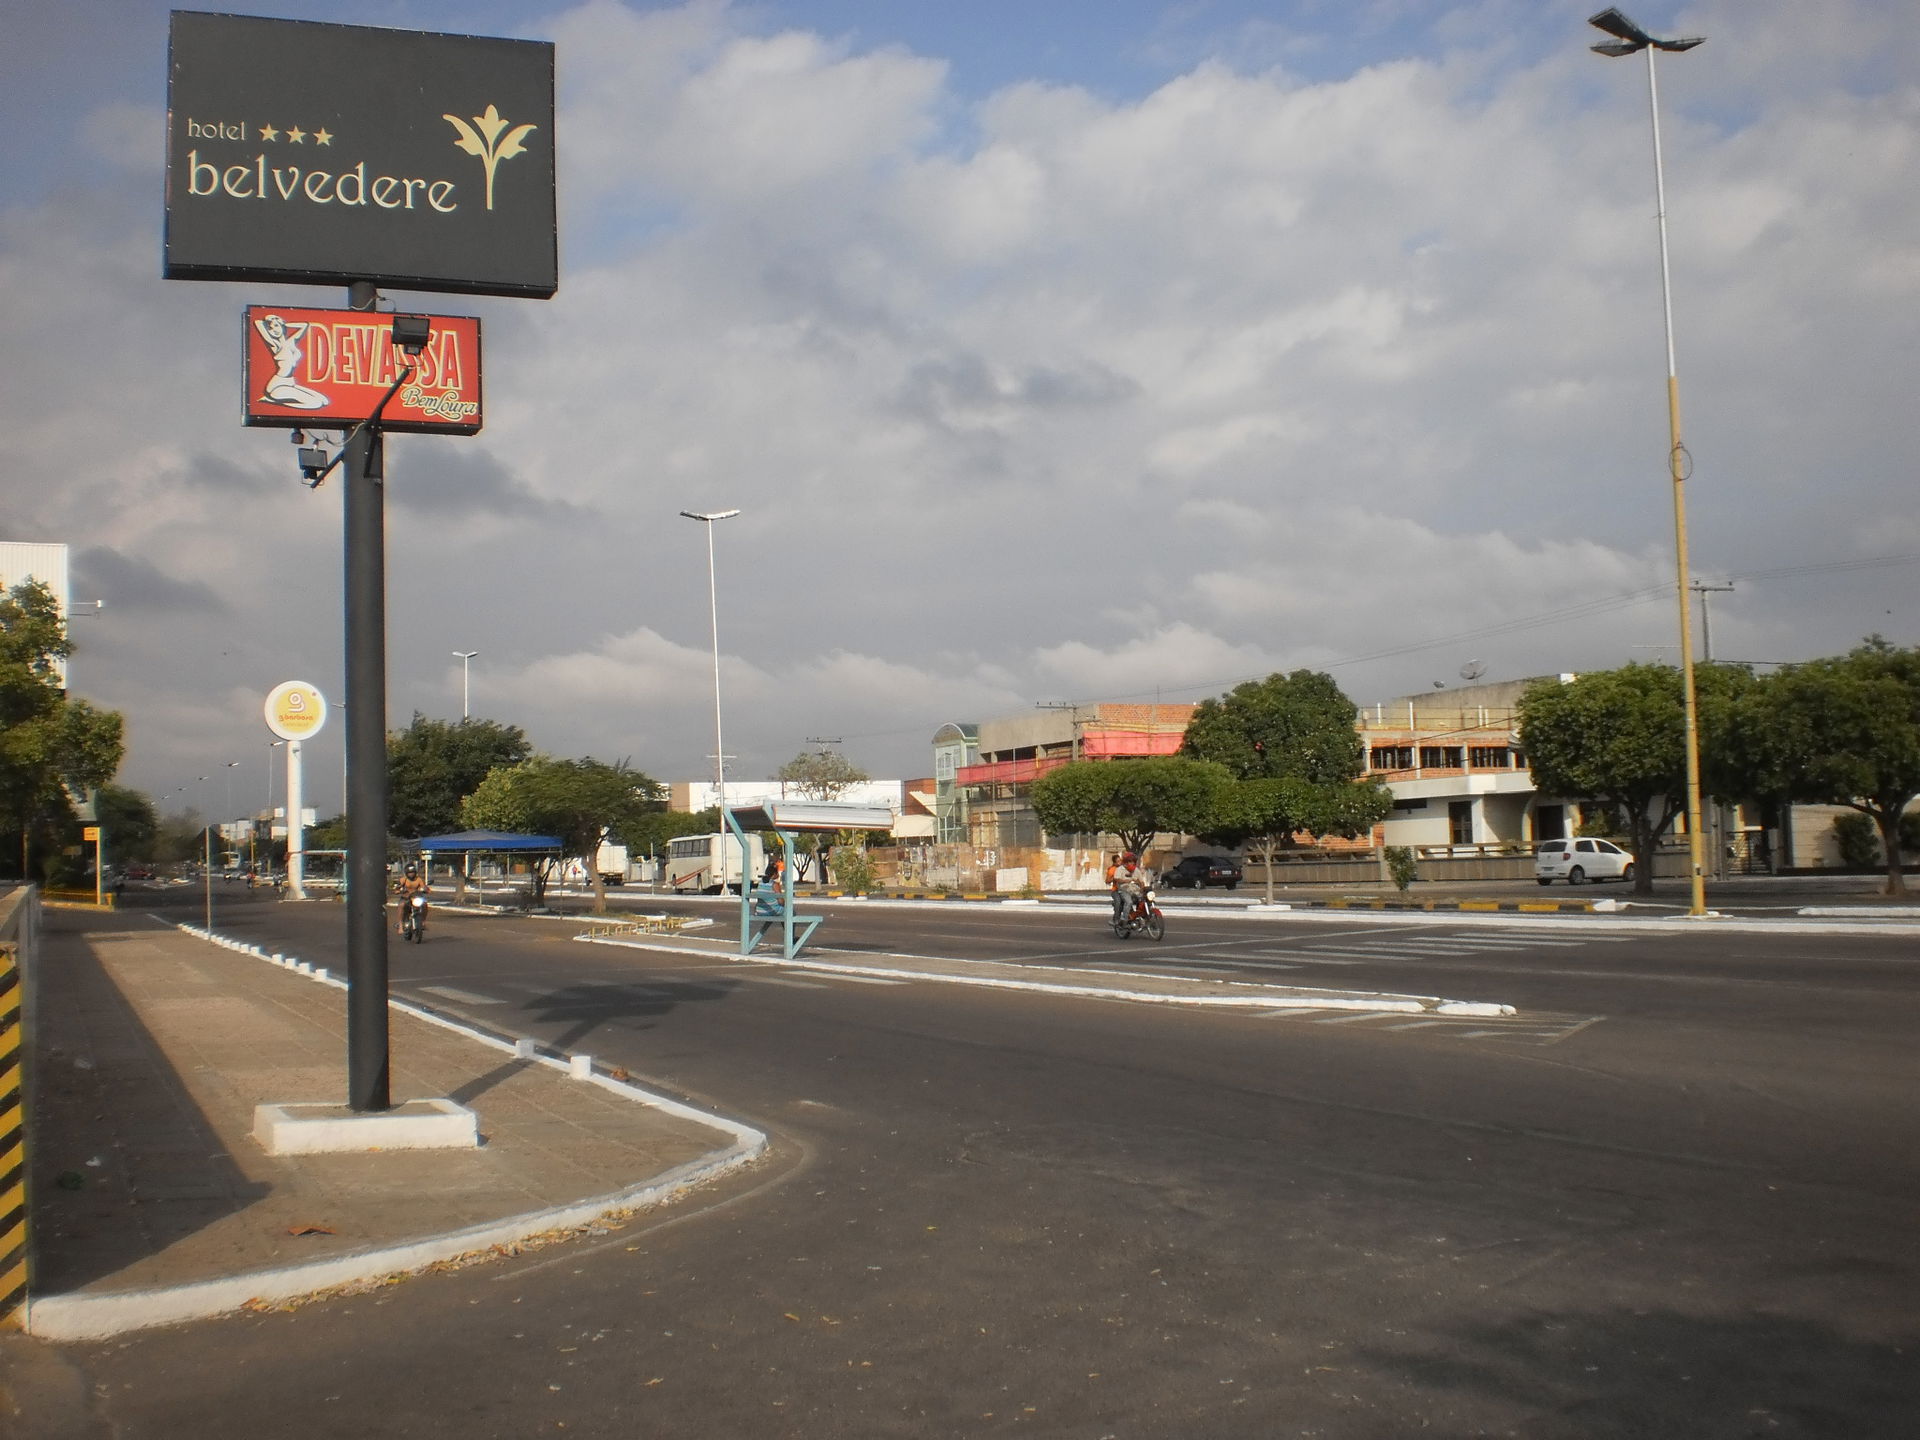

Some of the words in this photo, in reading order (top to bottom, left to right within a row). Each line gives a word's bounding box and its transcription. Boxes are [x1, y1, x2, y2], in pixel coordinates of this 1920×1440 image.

[188, 118, 246, 141] hotel
[187, 150, 458, 212] belvedere
[402, 386, 438, 407] Bem
[424, 390, 477, 420] Loura
